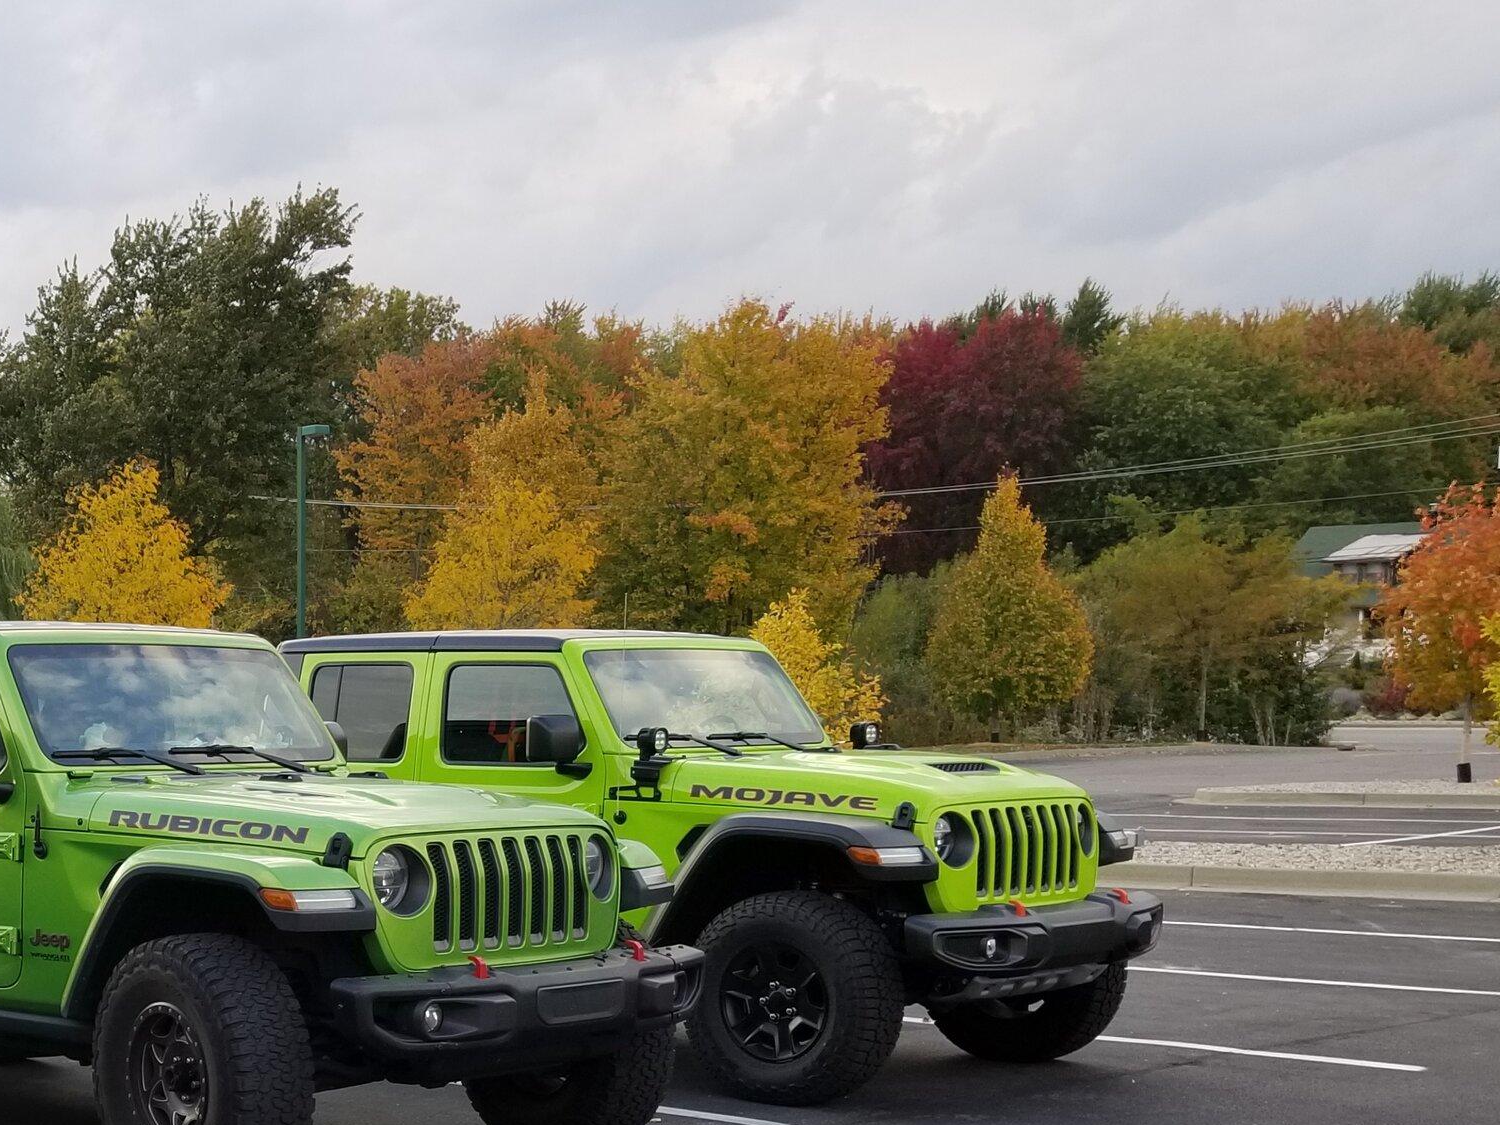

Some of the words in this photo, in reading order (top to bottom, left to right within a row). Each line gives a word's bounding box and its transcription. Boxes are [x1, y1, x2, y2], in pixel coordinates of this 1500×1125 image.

[690, 785, 879, 811] MOJAVE
[108, 810, 310, 844] RUBICON
[30, 929, 70, 952] Jeep
